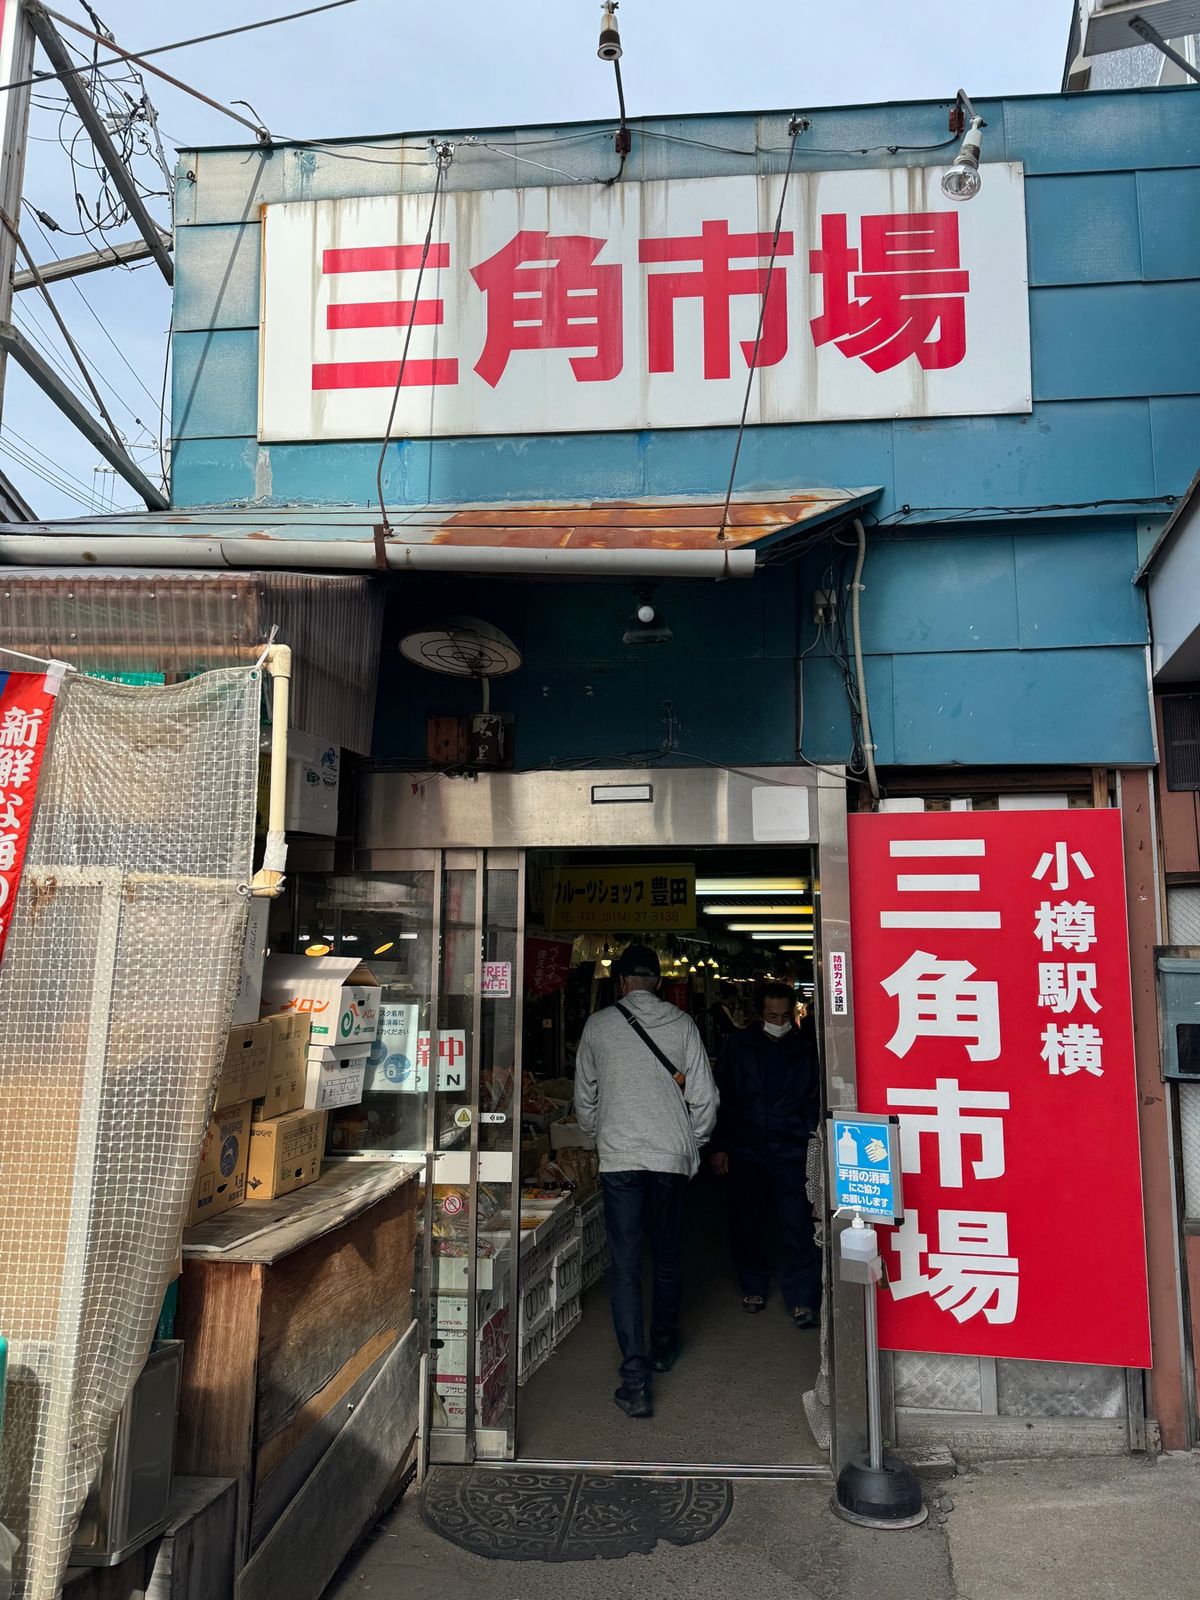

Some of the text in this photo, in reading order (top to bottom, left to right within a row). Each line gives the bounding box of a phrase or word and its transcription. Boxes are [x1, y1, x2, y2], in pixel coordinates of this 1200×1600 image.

[312, 211, 970, 390] 三角市場
[651, 876, 687, 906] 豊田
[1031, 841, 1104, 1077] 小樽駅横
[833, 955, 844, 1012] 防犯カメラ設置
[281, 997, 330, 1013] メロン
[880, 839, 1019, 1325] 三角市場
[838, 1168, 890, 1185] 手指の消毒
[842, 1193, 888, 1207] お願いします
[849, 1182, 880, 1195] にご協力
[446, 1386, 480, 1394] アサヒメン
